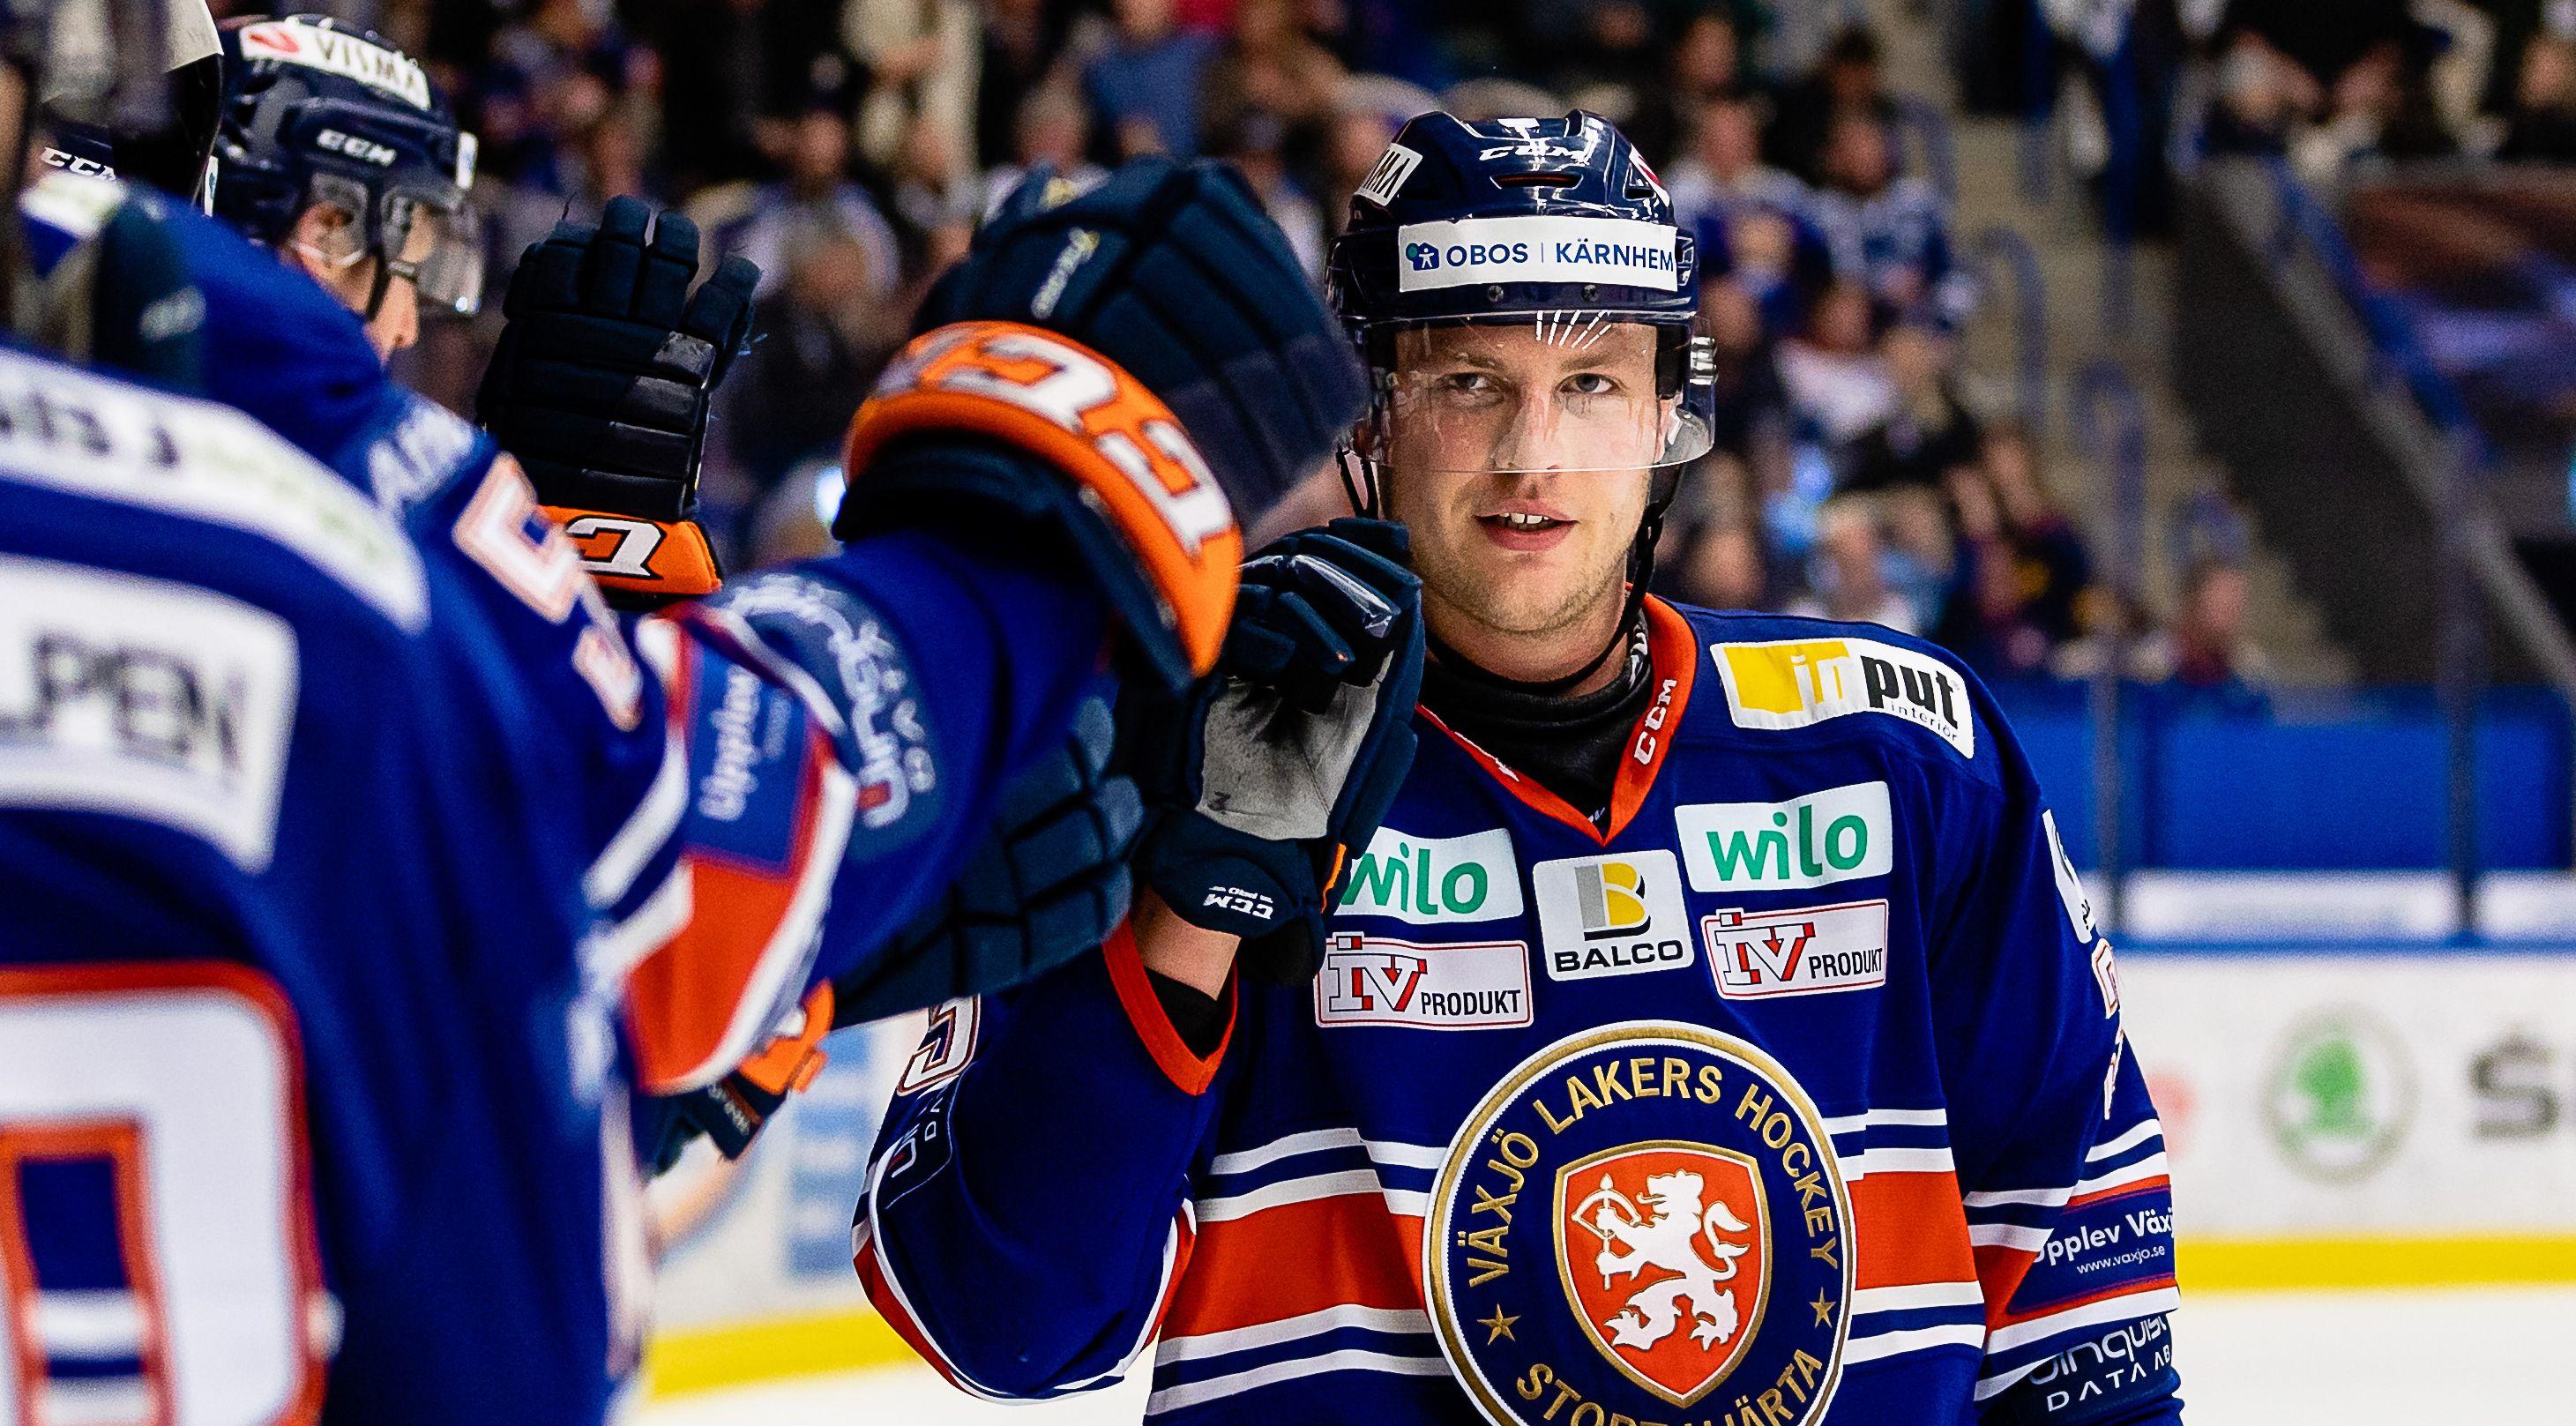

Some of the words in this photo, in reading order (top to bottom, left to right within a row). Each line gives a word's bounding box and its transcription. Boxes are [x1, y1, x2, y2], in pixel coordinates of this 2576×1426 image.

[317, 129, 397, 167] CCM
[1446, 243, 1528, 267] OBOS
[1557, 238, 1674, 272] KÄRNHEM
[1633, 678, 1677, 765] CCM
[1706, 804, 1868, 882] wilo
[1340, 842, 1488, 915] wilo
[1202, 893, 1273, 920] CCM
[1554, 938, 1684, 973] BALCO
[1808, 947, 1883, 980] PRODUKT
[1420, 989, 1521, 1016] PRODUKT
[1458, 1128, 1539, 1288] VÄXJÖ
[1533, 1057, 1723, 1136] LAKERS
[1735, 1083, 1839, 1271] HOCKEY
[2125, 1206, 2174, 1238] Växj
[2077, 1245, 2166, 1274] www.vaxjo.se
[1517, 1363, 1669, 1426] STO
[1684, 1349, 1823, 1426] ÄRTA
